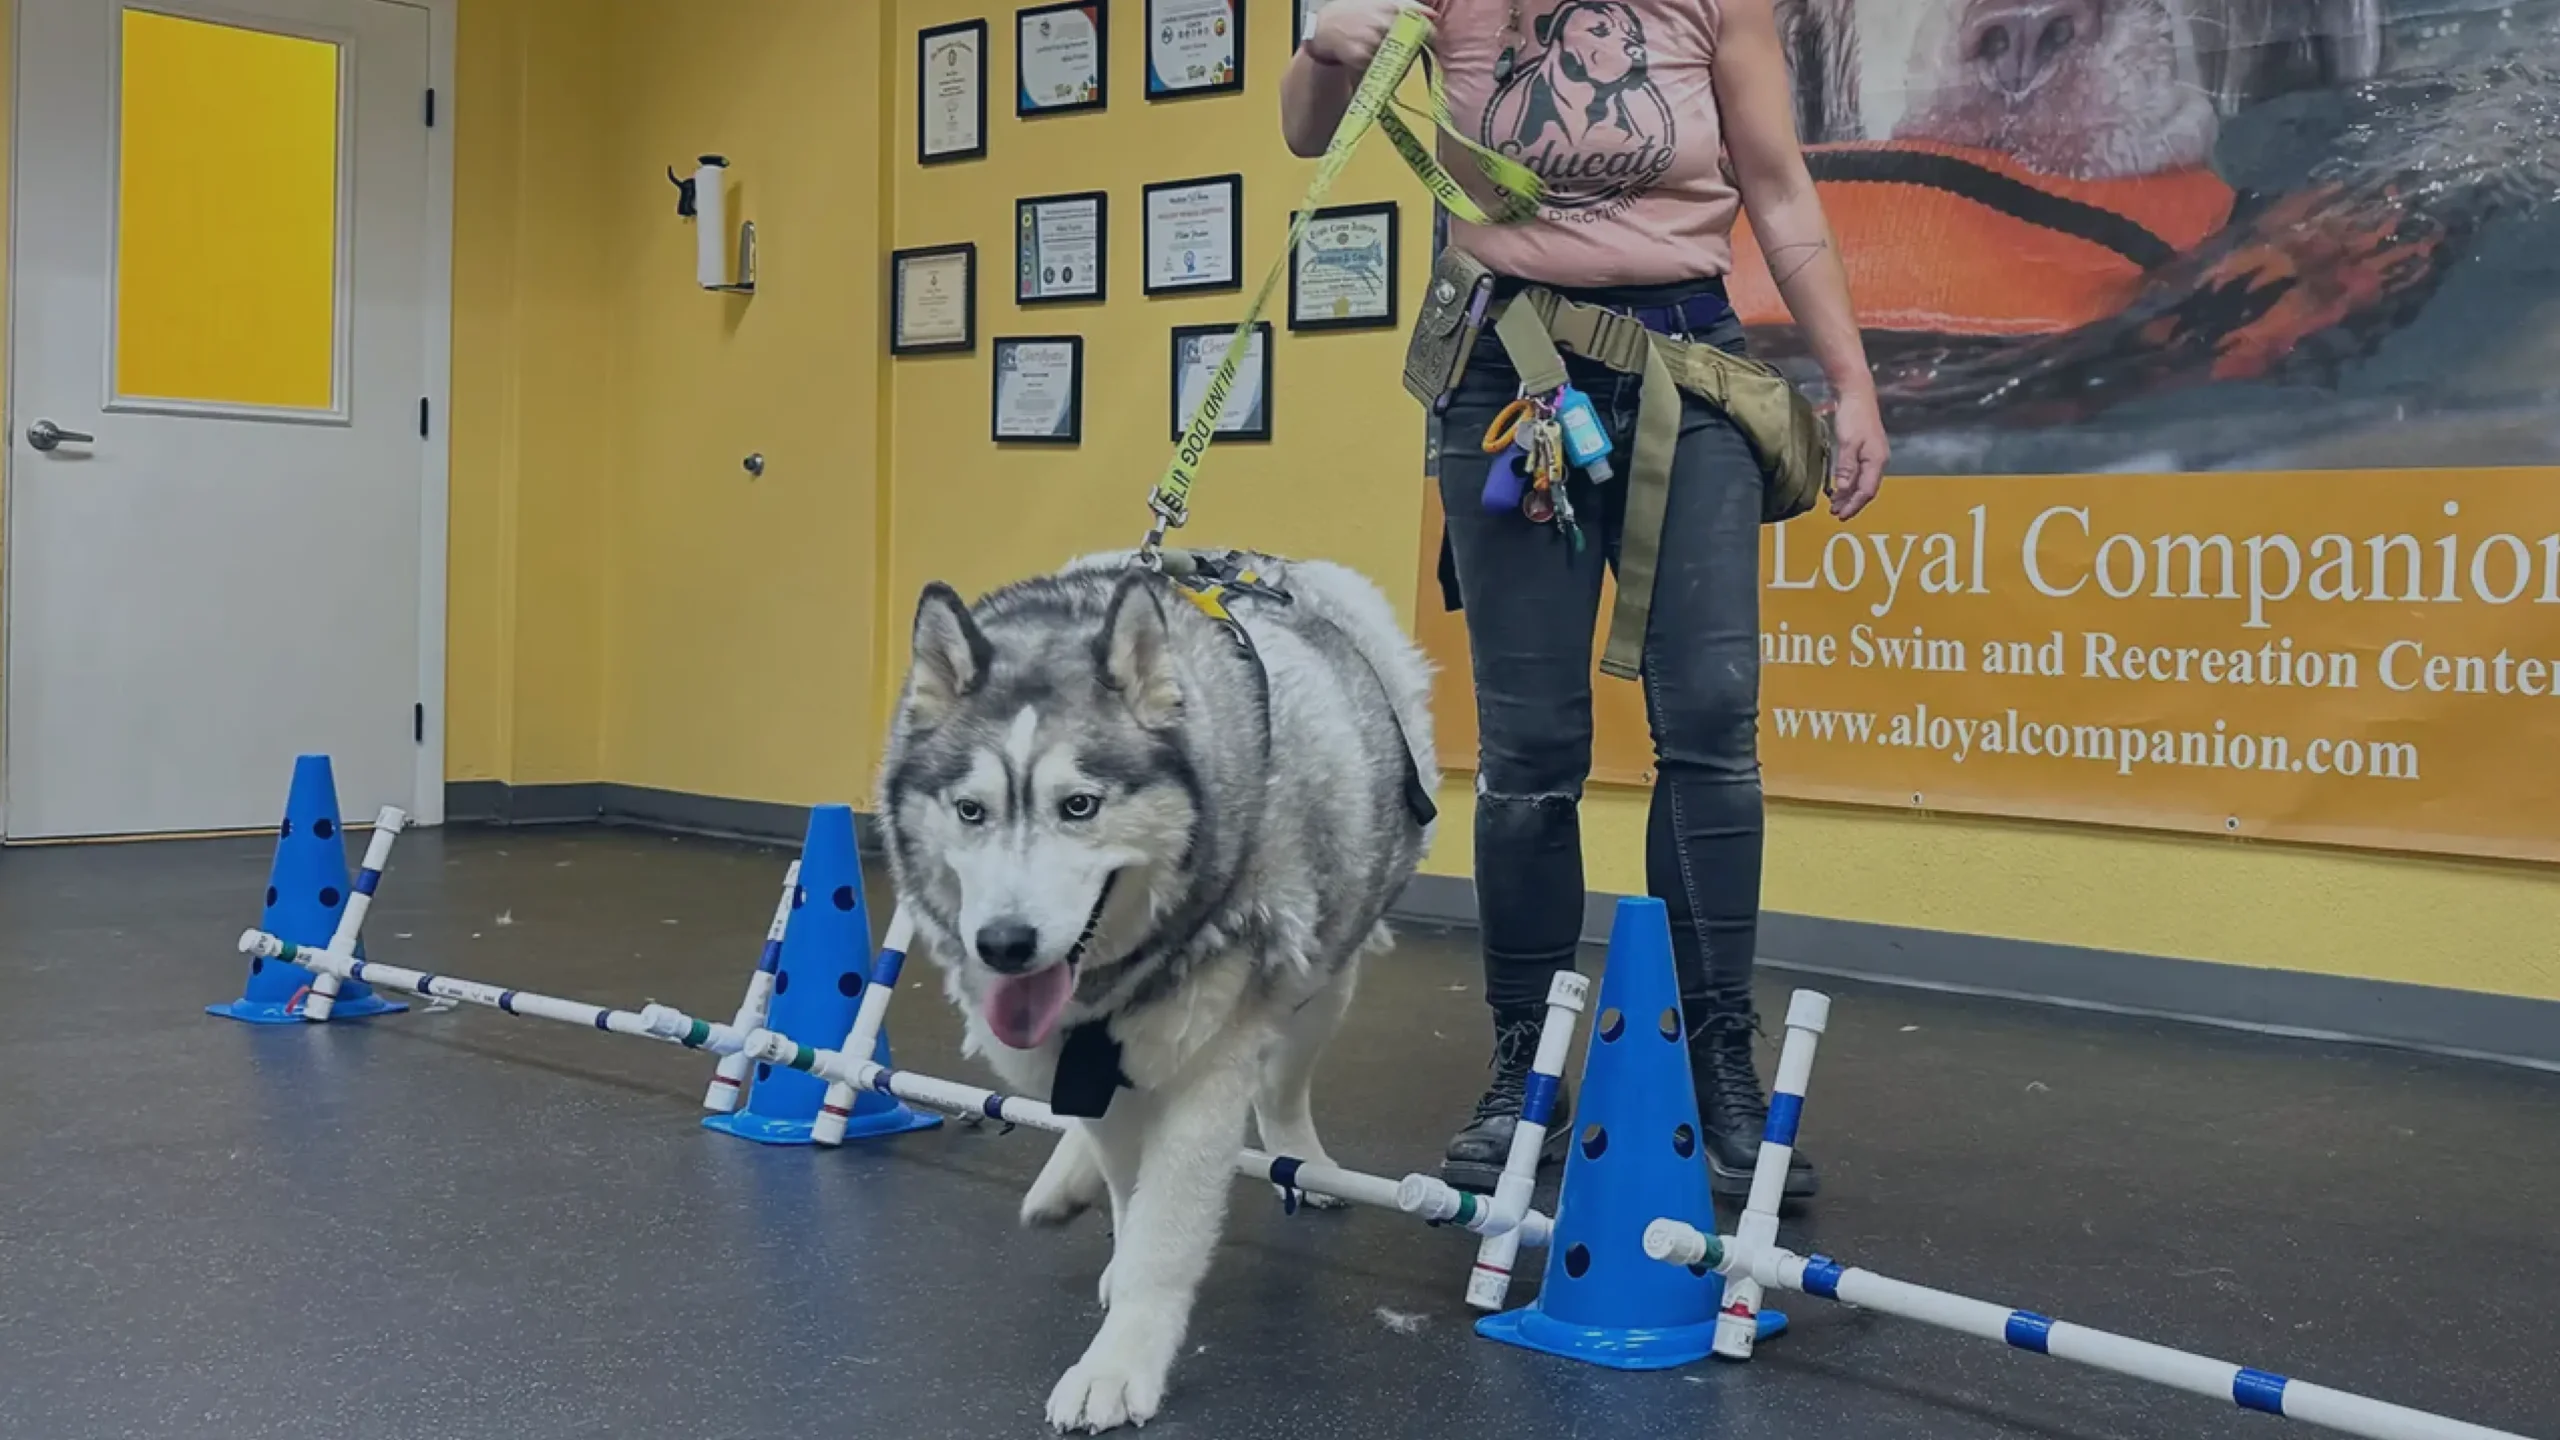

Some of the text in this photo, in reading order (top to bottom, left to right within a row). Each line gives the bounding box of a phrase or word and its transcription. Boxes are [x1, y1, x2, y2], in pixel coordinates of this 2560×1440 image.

[1181, 418, 1211, 467] DOG
[1766, 504, 1990, 617] Loyal
[1850, 624, 1967, 672] Swim
[1982, 631, 2065, 676] and
[2081, 632, 2358, 689] Recreation
[1773, 703, 2420, 779] www.aloyalcompanion.com
